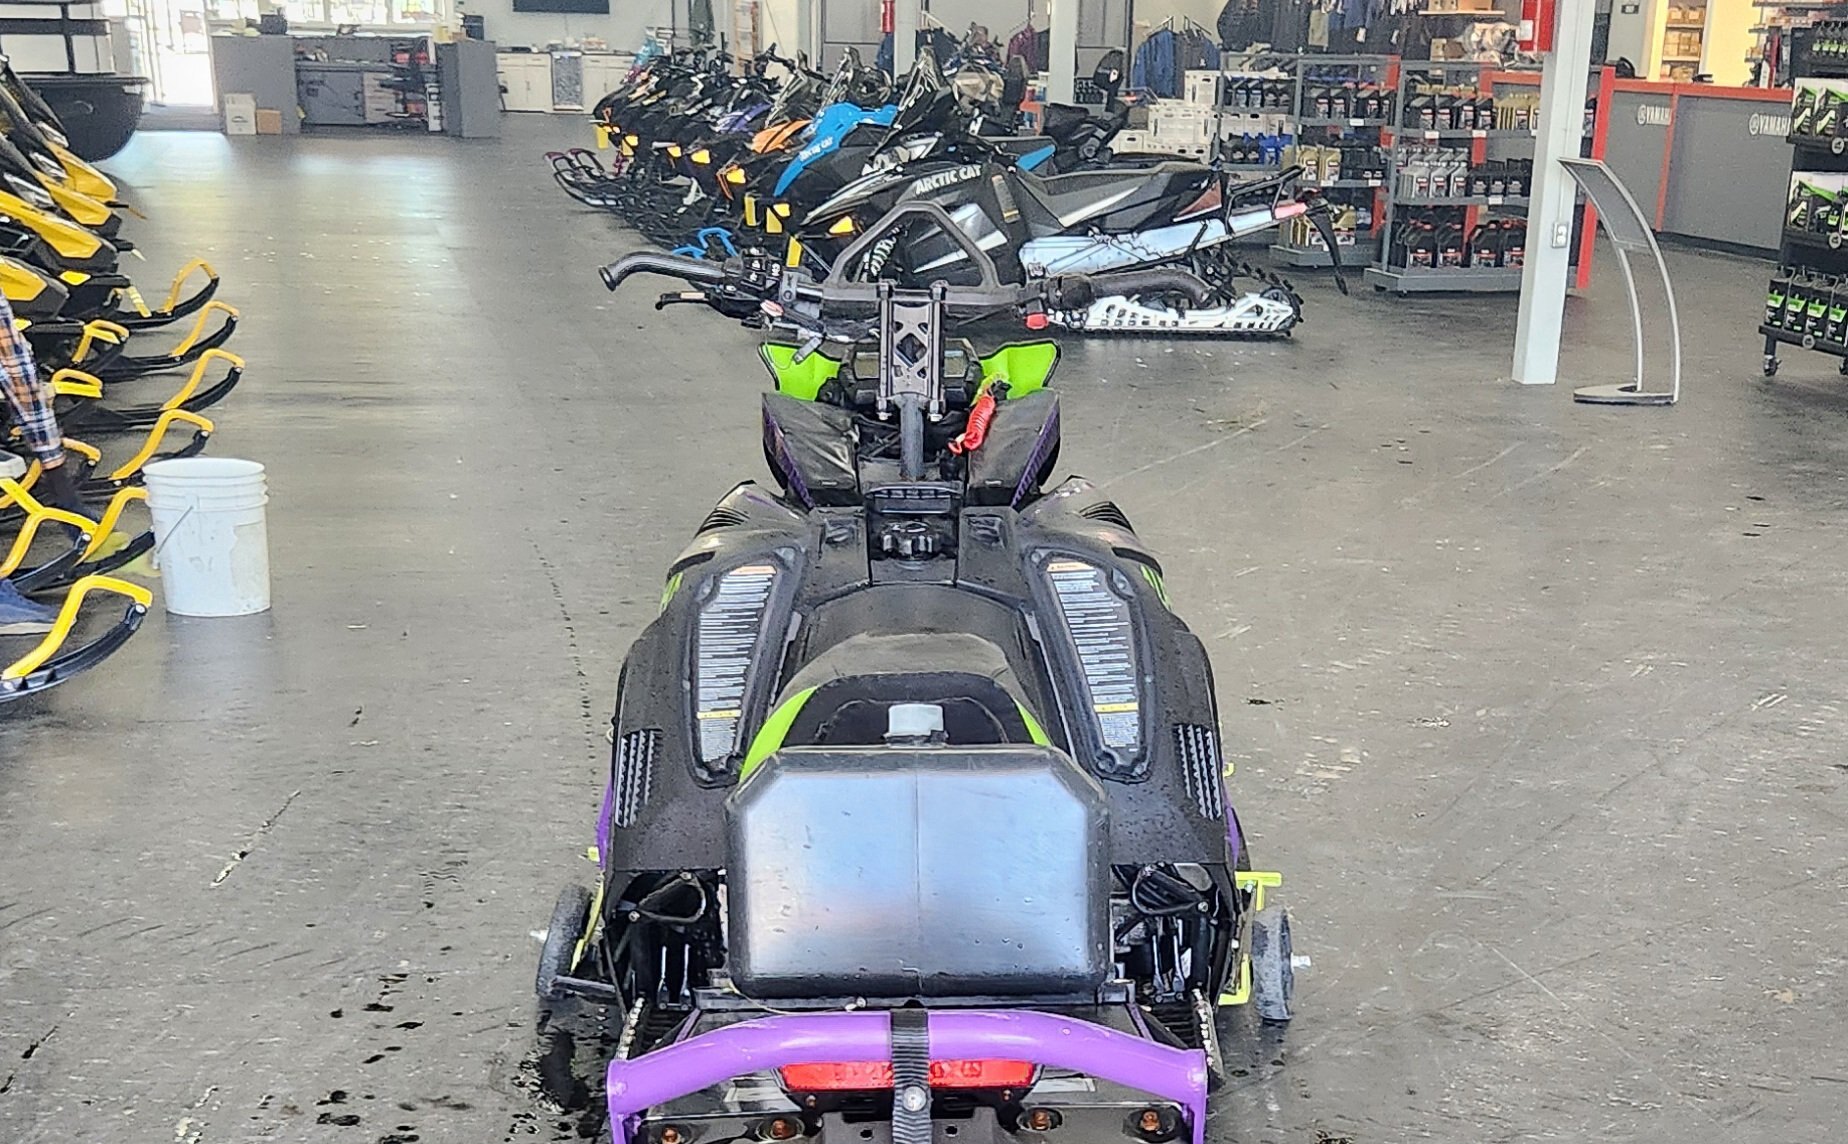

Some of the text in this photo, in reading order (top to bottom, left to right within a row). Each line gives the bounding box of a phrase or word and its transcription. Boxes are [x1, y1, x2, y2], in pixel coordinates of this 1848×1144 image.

[1646, 105, 1672, 125] YAMAH
[1759, 114, 1791, 136] YAMAH
[915, 164, 981, 195] ARCTIC CAT
